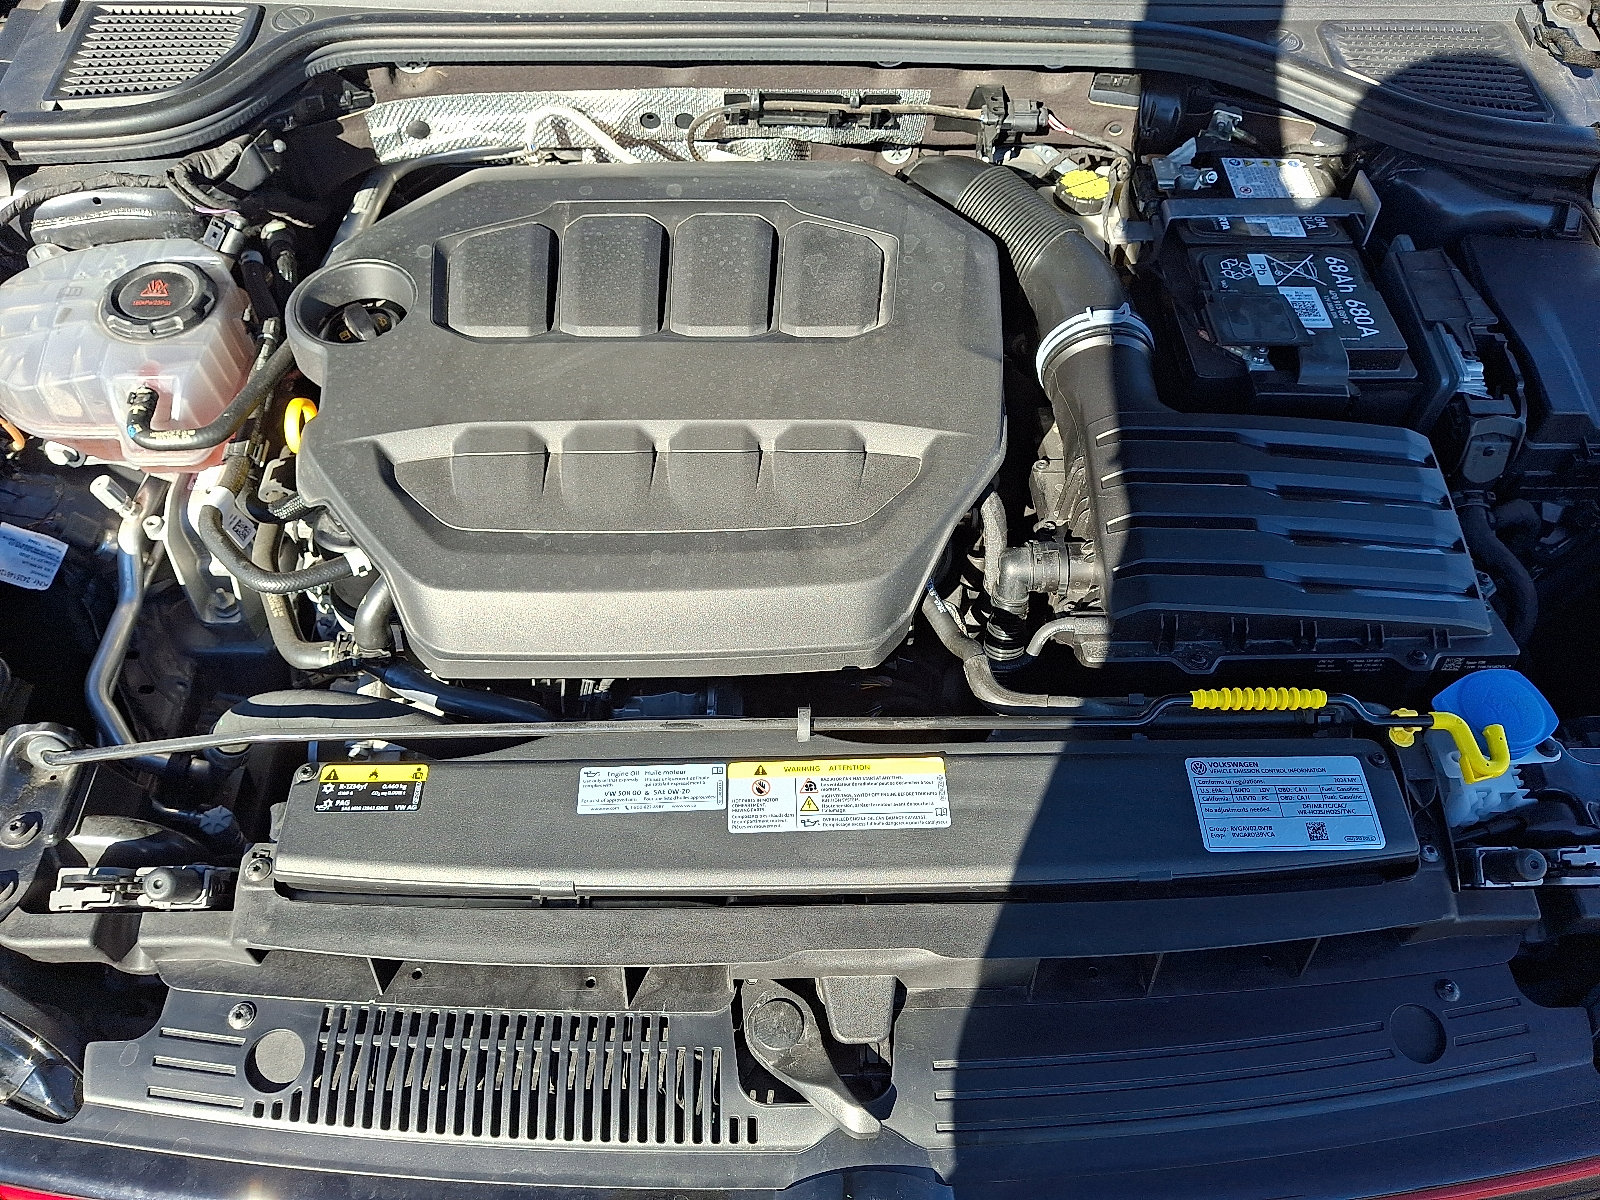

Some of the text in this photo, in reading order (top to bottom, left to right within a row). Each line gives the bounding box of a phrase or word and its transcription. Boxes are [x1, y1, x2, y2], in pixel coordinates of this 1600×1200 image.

[1254, 263, 1267, 276] Pb
[1324, 256, 1357, 294] 68Ah
[1345, 299, 1380, 338] 680A
